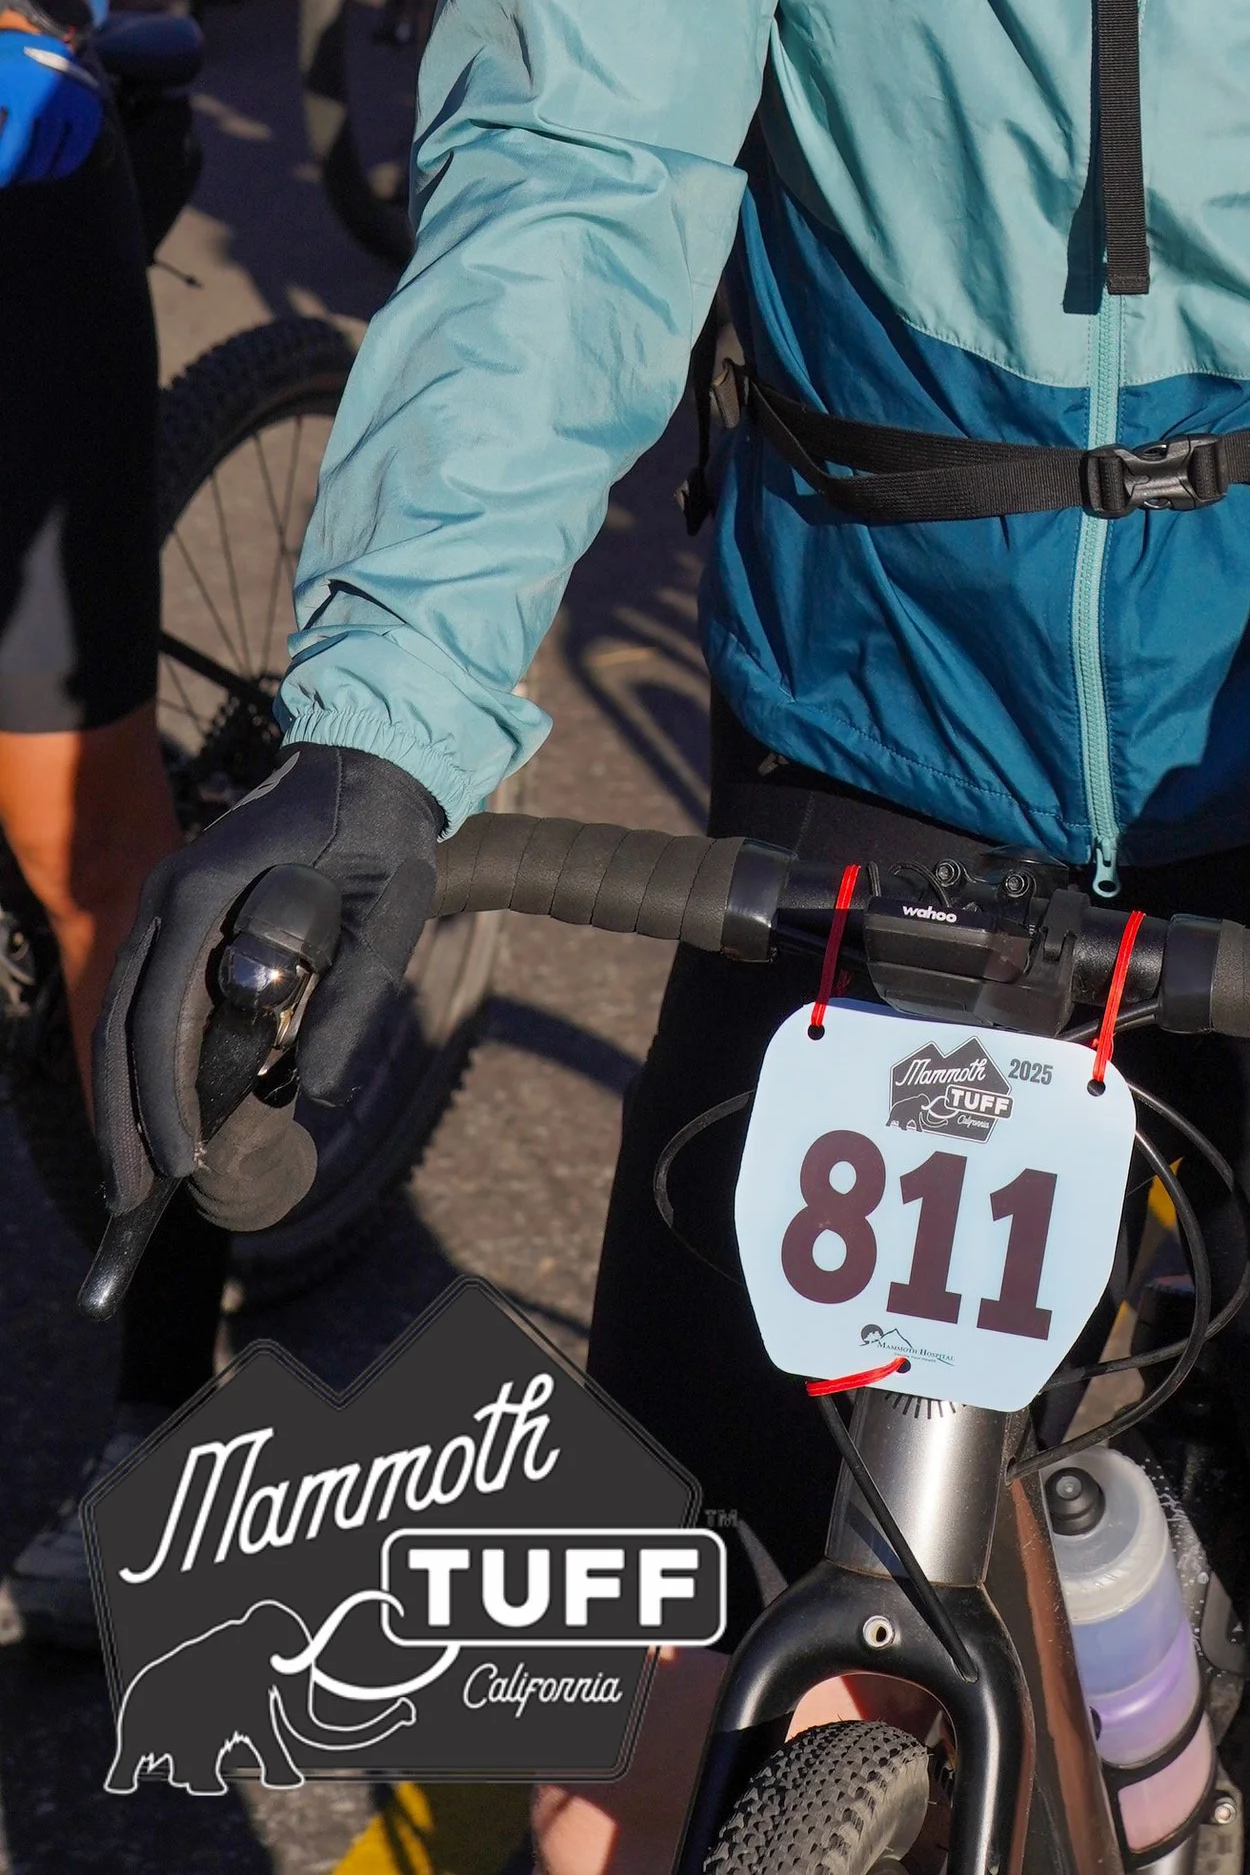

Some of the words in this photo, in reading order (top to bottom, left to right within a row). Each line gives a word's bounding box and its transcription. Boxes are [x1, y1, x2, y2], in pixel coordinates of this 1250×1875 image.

[902, 905, 957, 923] wahoo
[895, 1058, 988, 1086] Mammoth
[1008, 1058, 1053, 1086] 2025
[951, 1088, 1010, 1115] TUFF
[956, 1115, 990, 1129] California
[781, 1129, 1058, 1340] 811
